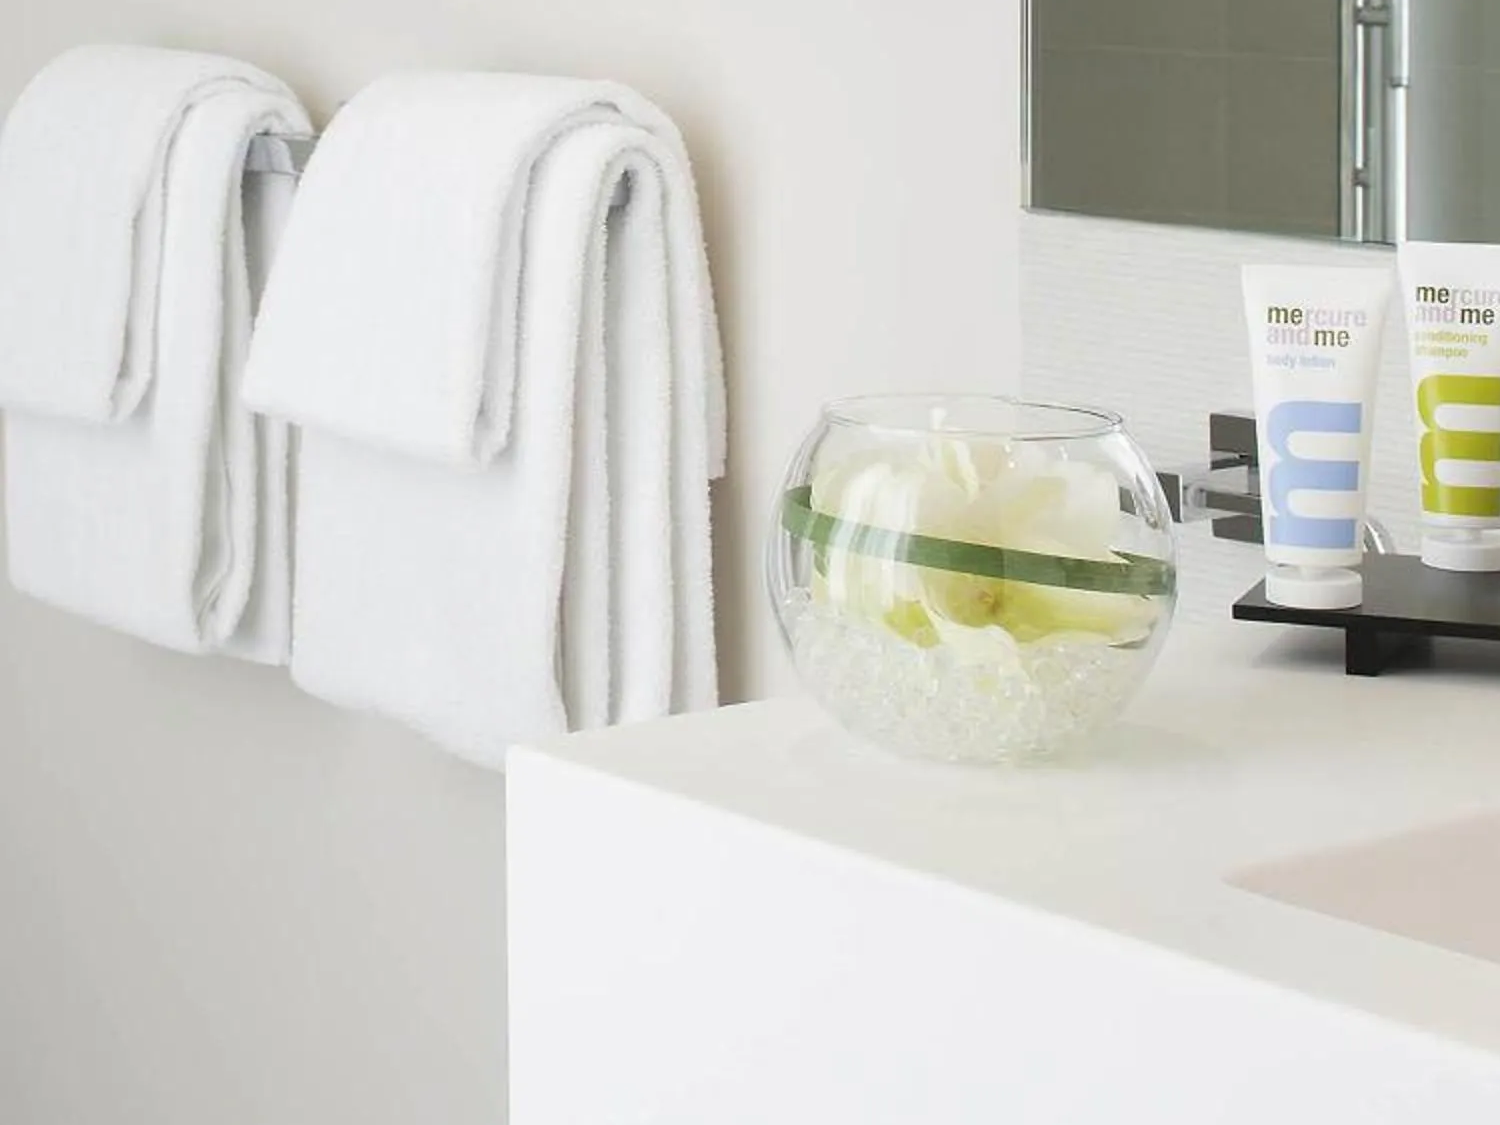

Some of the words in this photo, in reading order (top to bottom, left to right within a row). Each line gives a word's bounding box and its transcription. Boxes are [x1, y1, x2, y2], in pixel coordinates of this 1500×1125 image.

[1267, 306, 1367, 327] mercure
[1415, 305, 1456, 323] and
[1460, 307, 1495, 325] me
[1266, 327, 1309, 345] and
[1314, 329, 1350, 347] me
